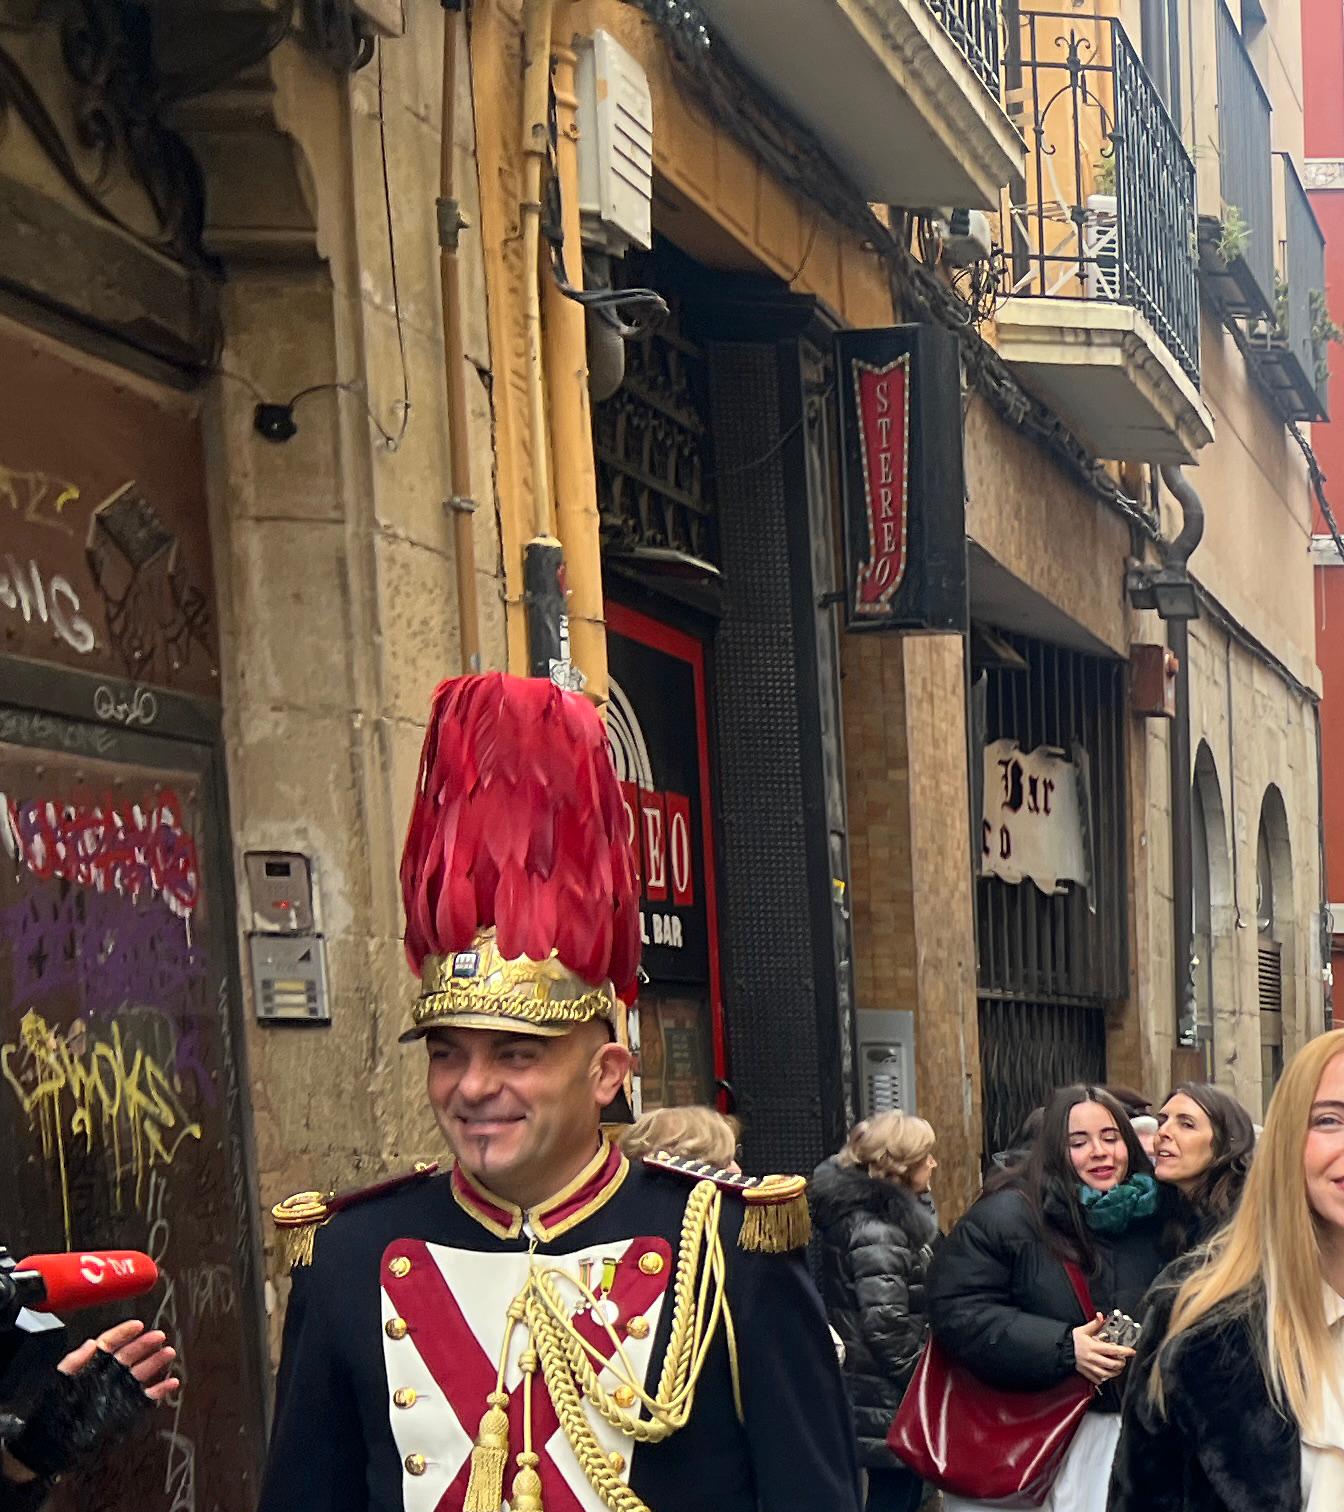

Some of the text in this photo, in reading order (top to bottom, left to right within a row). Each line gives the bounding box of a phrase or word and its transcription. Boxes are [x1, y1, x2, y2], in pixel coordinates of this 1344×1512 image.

[875, 381, 897, 586] STEREO
[998, 757, 1055, 816] Bar
[652, 913, 684, 949] BAR
